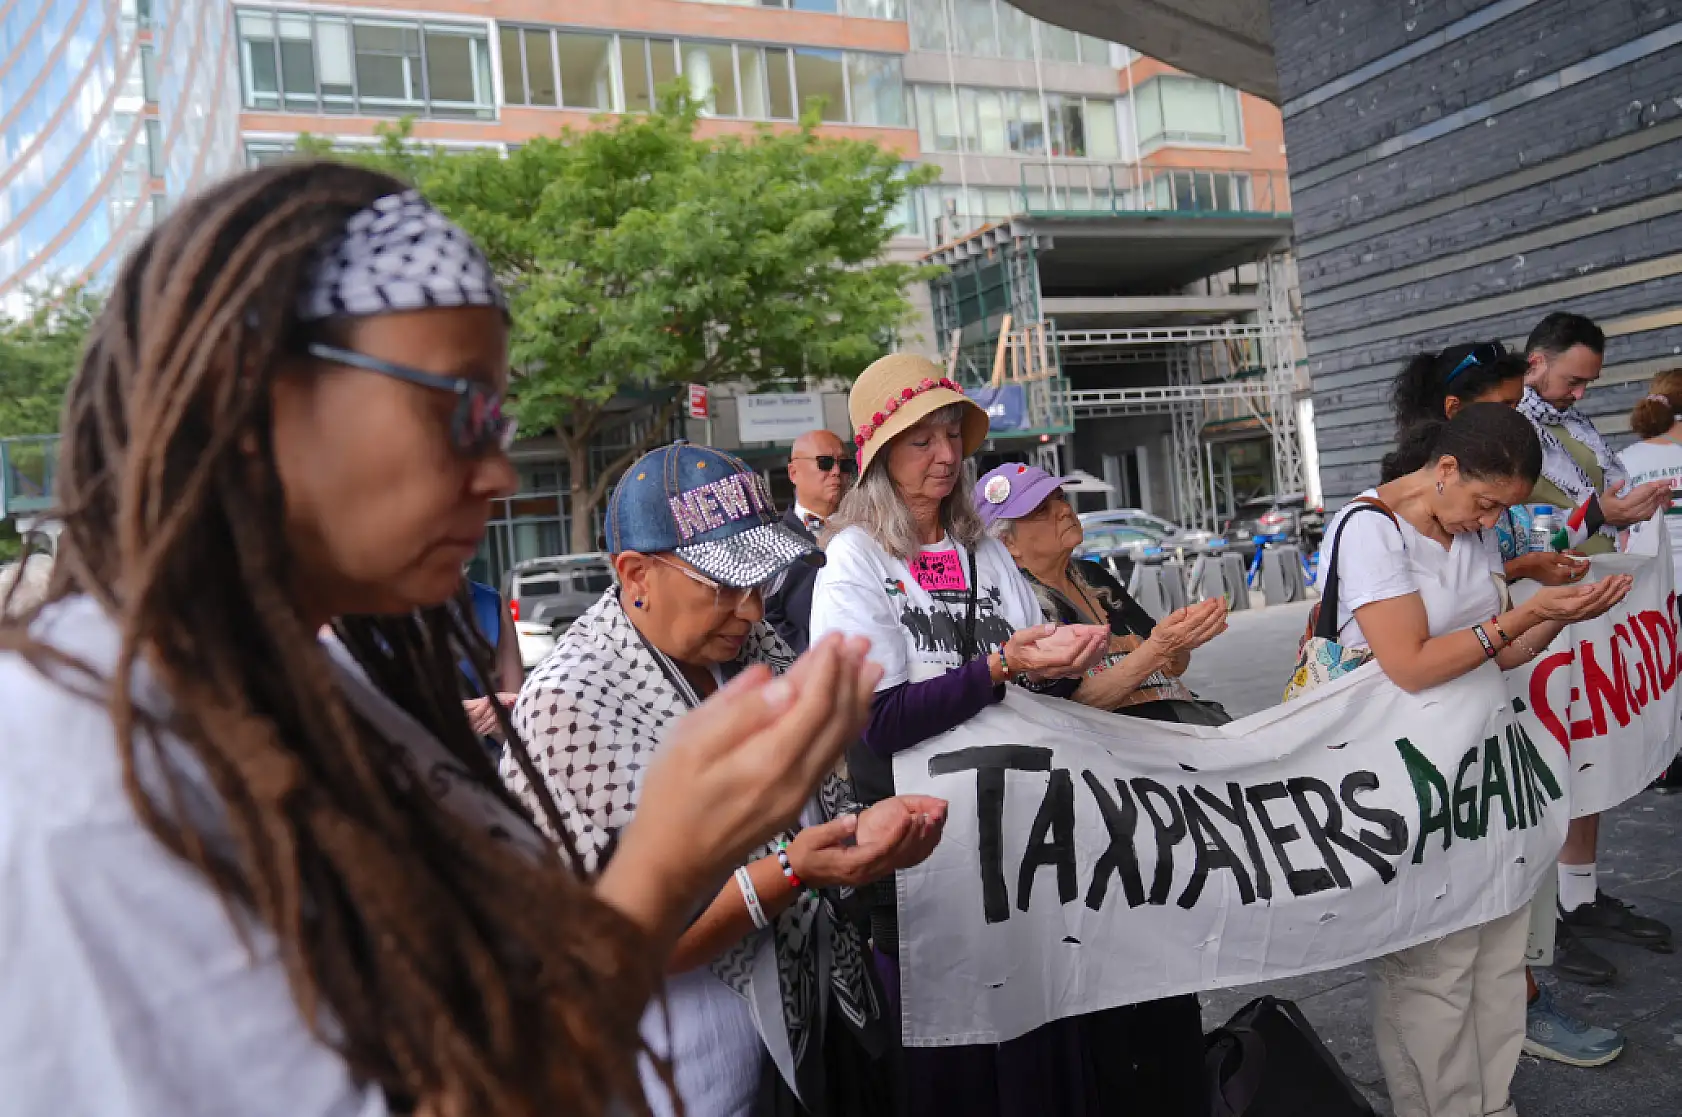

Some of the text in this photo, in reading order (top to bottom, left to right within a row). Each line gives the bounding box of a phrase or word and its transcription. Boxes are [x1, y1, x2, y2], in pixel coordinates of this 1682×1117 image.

[669, 474, 750, 540] NEW
[929, 743, 1408, 925] TAXPAYERS
[1395, 697, 1563, 865] AGAIN
